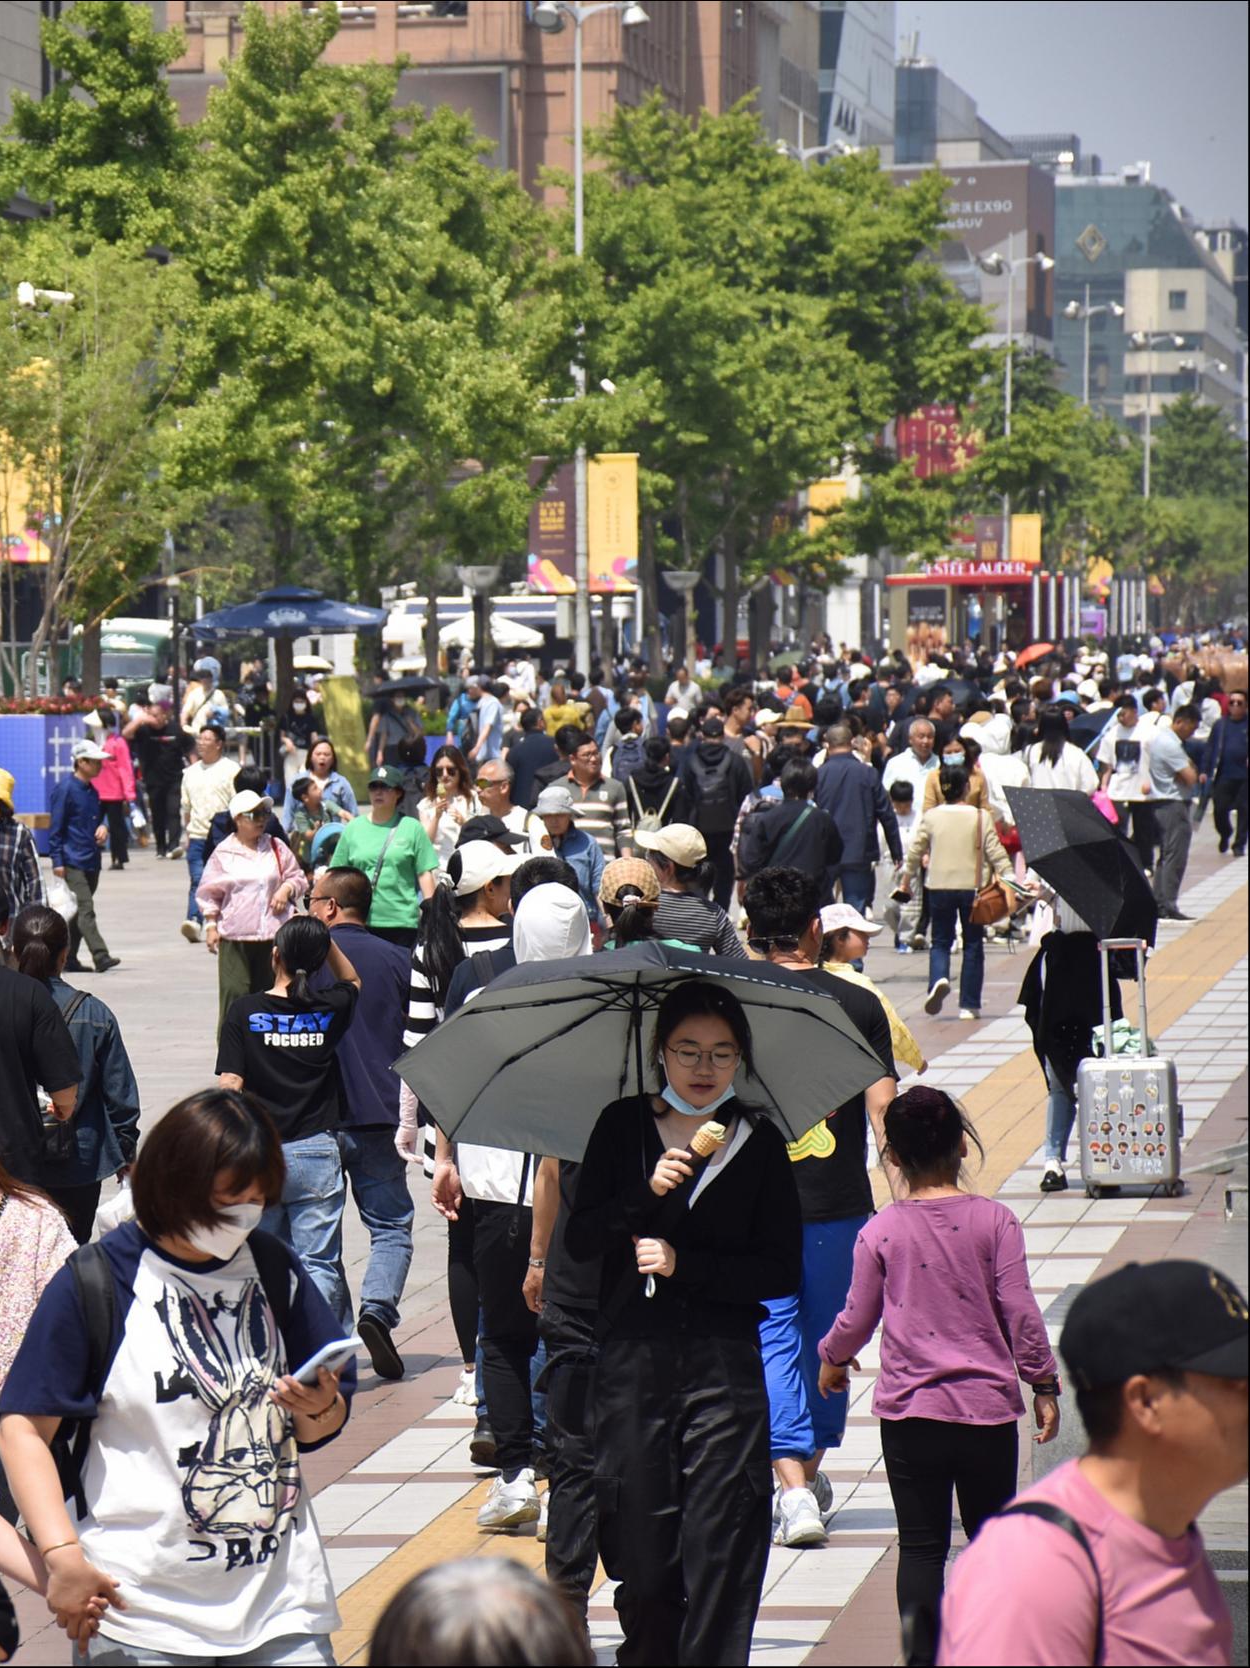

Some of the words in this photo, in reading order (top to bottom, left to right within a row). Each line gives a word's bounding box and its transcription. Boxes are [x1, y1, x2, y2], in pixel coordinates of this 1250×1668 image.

[969, 562, 1027, 576] LAUDER
[248, 1012, 335, 1033] STAY
[264, 1033, 324, 1047] FOCUSED
